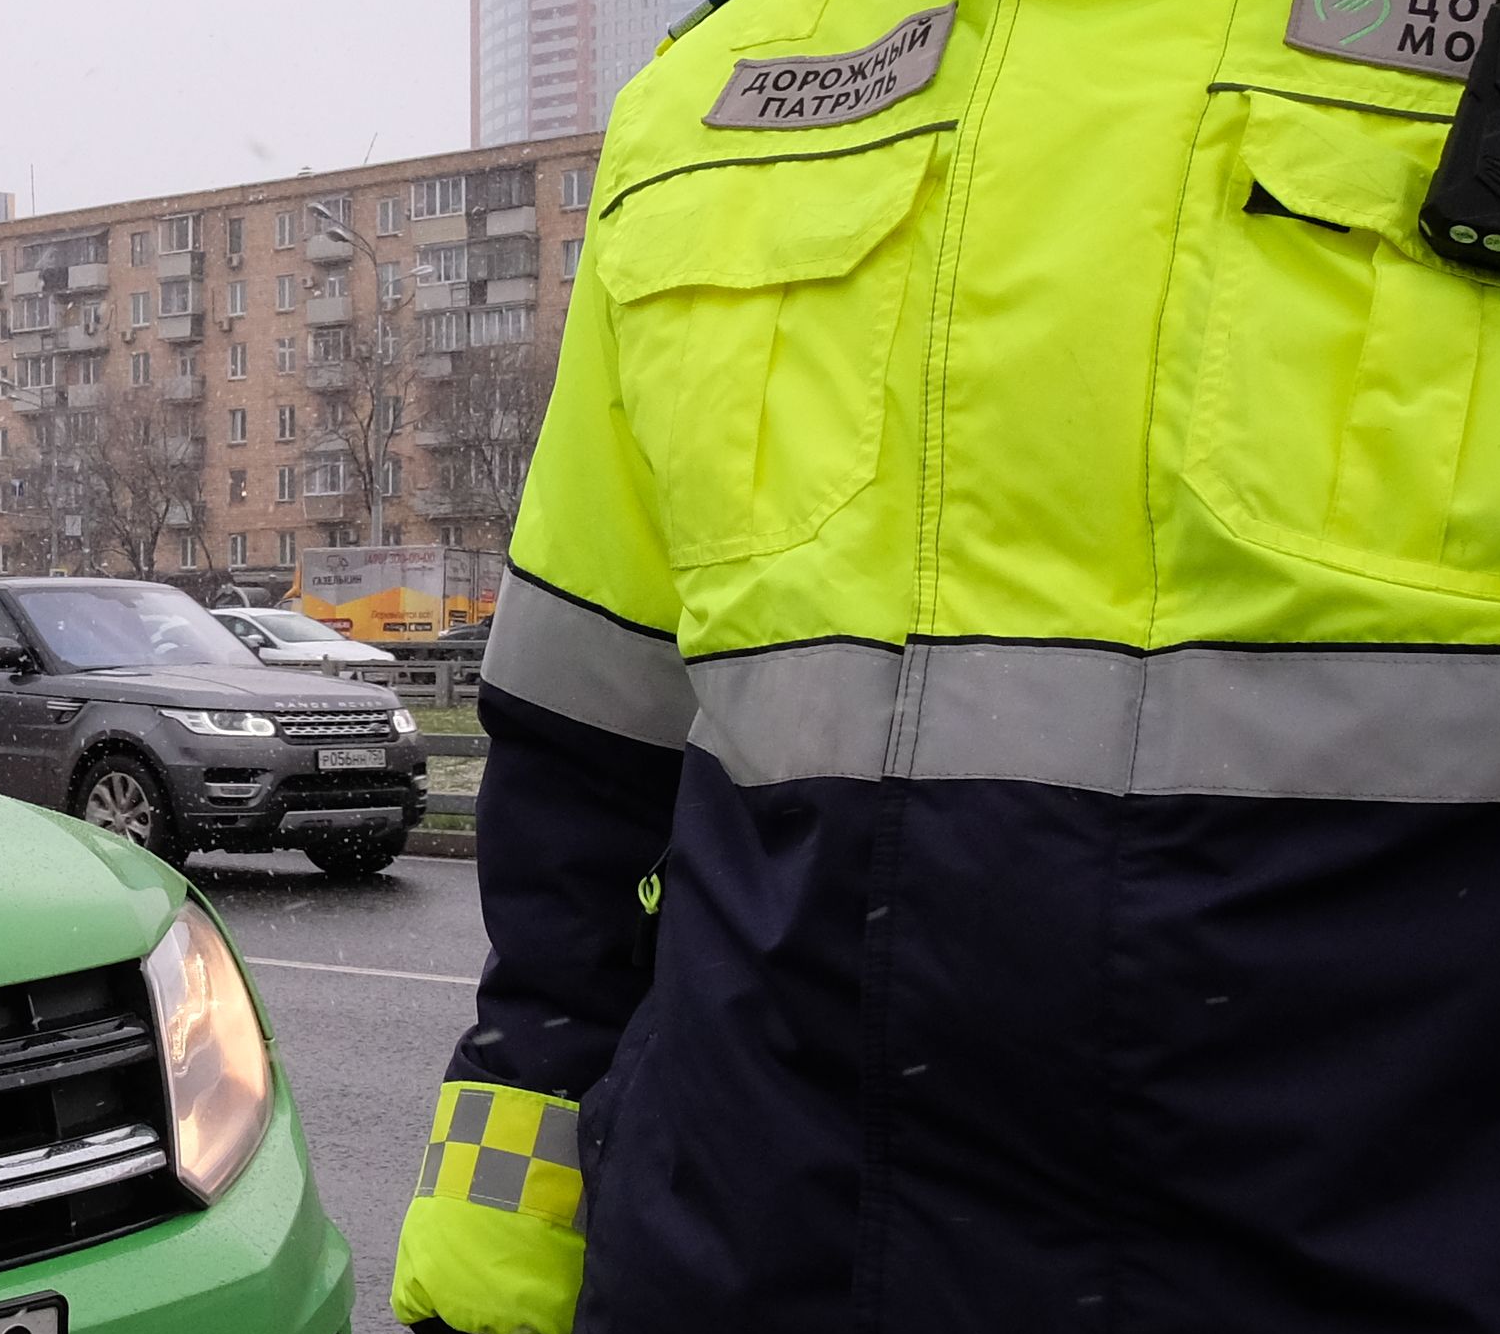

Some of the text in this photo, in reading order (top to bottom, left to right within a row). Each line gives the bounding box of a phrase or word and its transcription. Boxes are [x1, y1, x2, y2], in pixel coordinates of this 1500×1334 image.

[741, 17, 932, 96] ДОРОЖНЫЙ
[758, 72, 897, 118] ПАТРУЛЬ
[274, 700, 329, 709] RANGE
